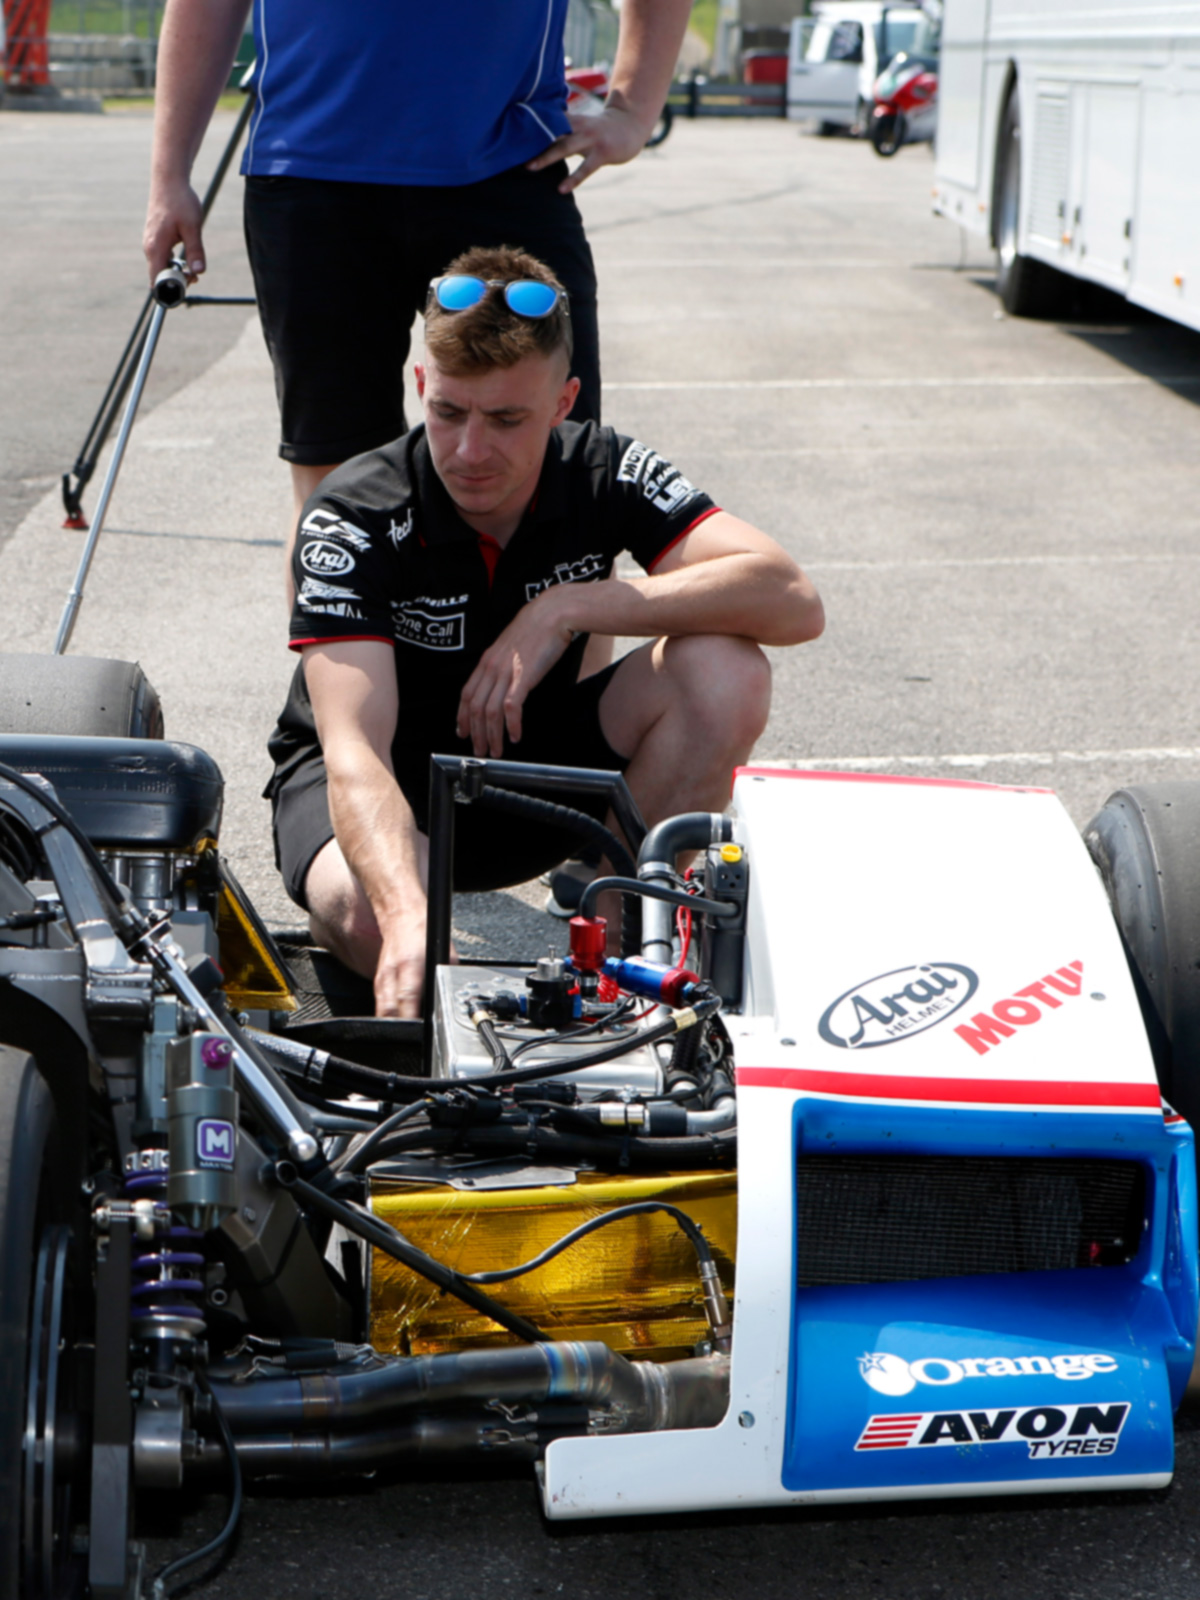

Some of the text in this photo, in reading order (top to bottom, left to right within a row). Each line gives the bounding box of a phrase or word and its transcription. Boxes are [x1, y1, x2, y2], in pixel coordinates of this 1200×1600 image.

[304, 542, 348, 570] Arai
[391, 612, 454, 637] One Call
[394, 624, 453, 645] NSURANCE
[849, 965, 958, 1046] Arai
[885, 996, 956, 1036] HELMET
[952, 960, 1084, 1056] MOTU
[909, 1353, 1119, 1388] Orange
[918, 1404, 1129, 1446] AVON
[1029, 1437, 1117, 1459] TYRES
